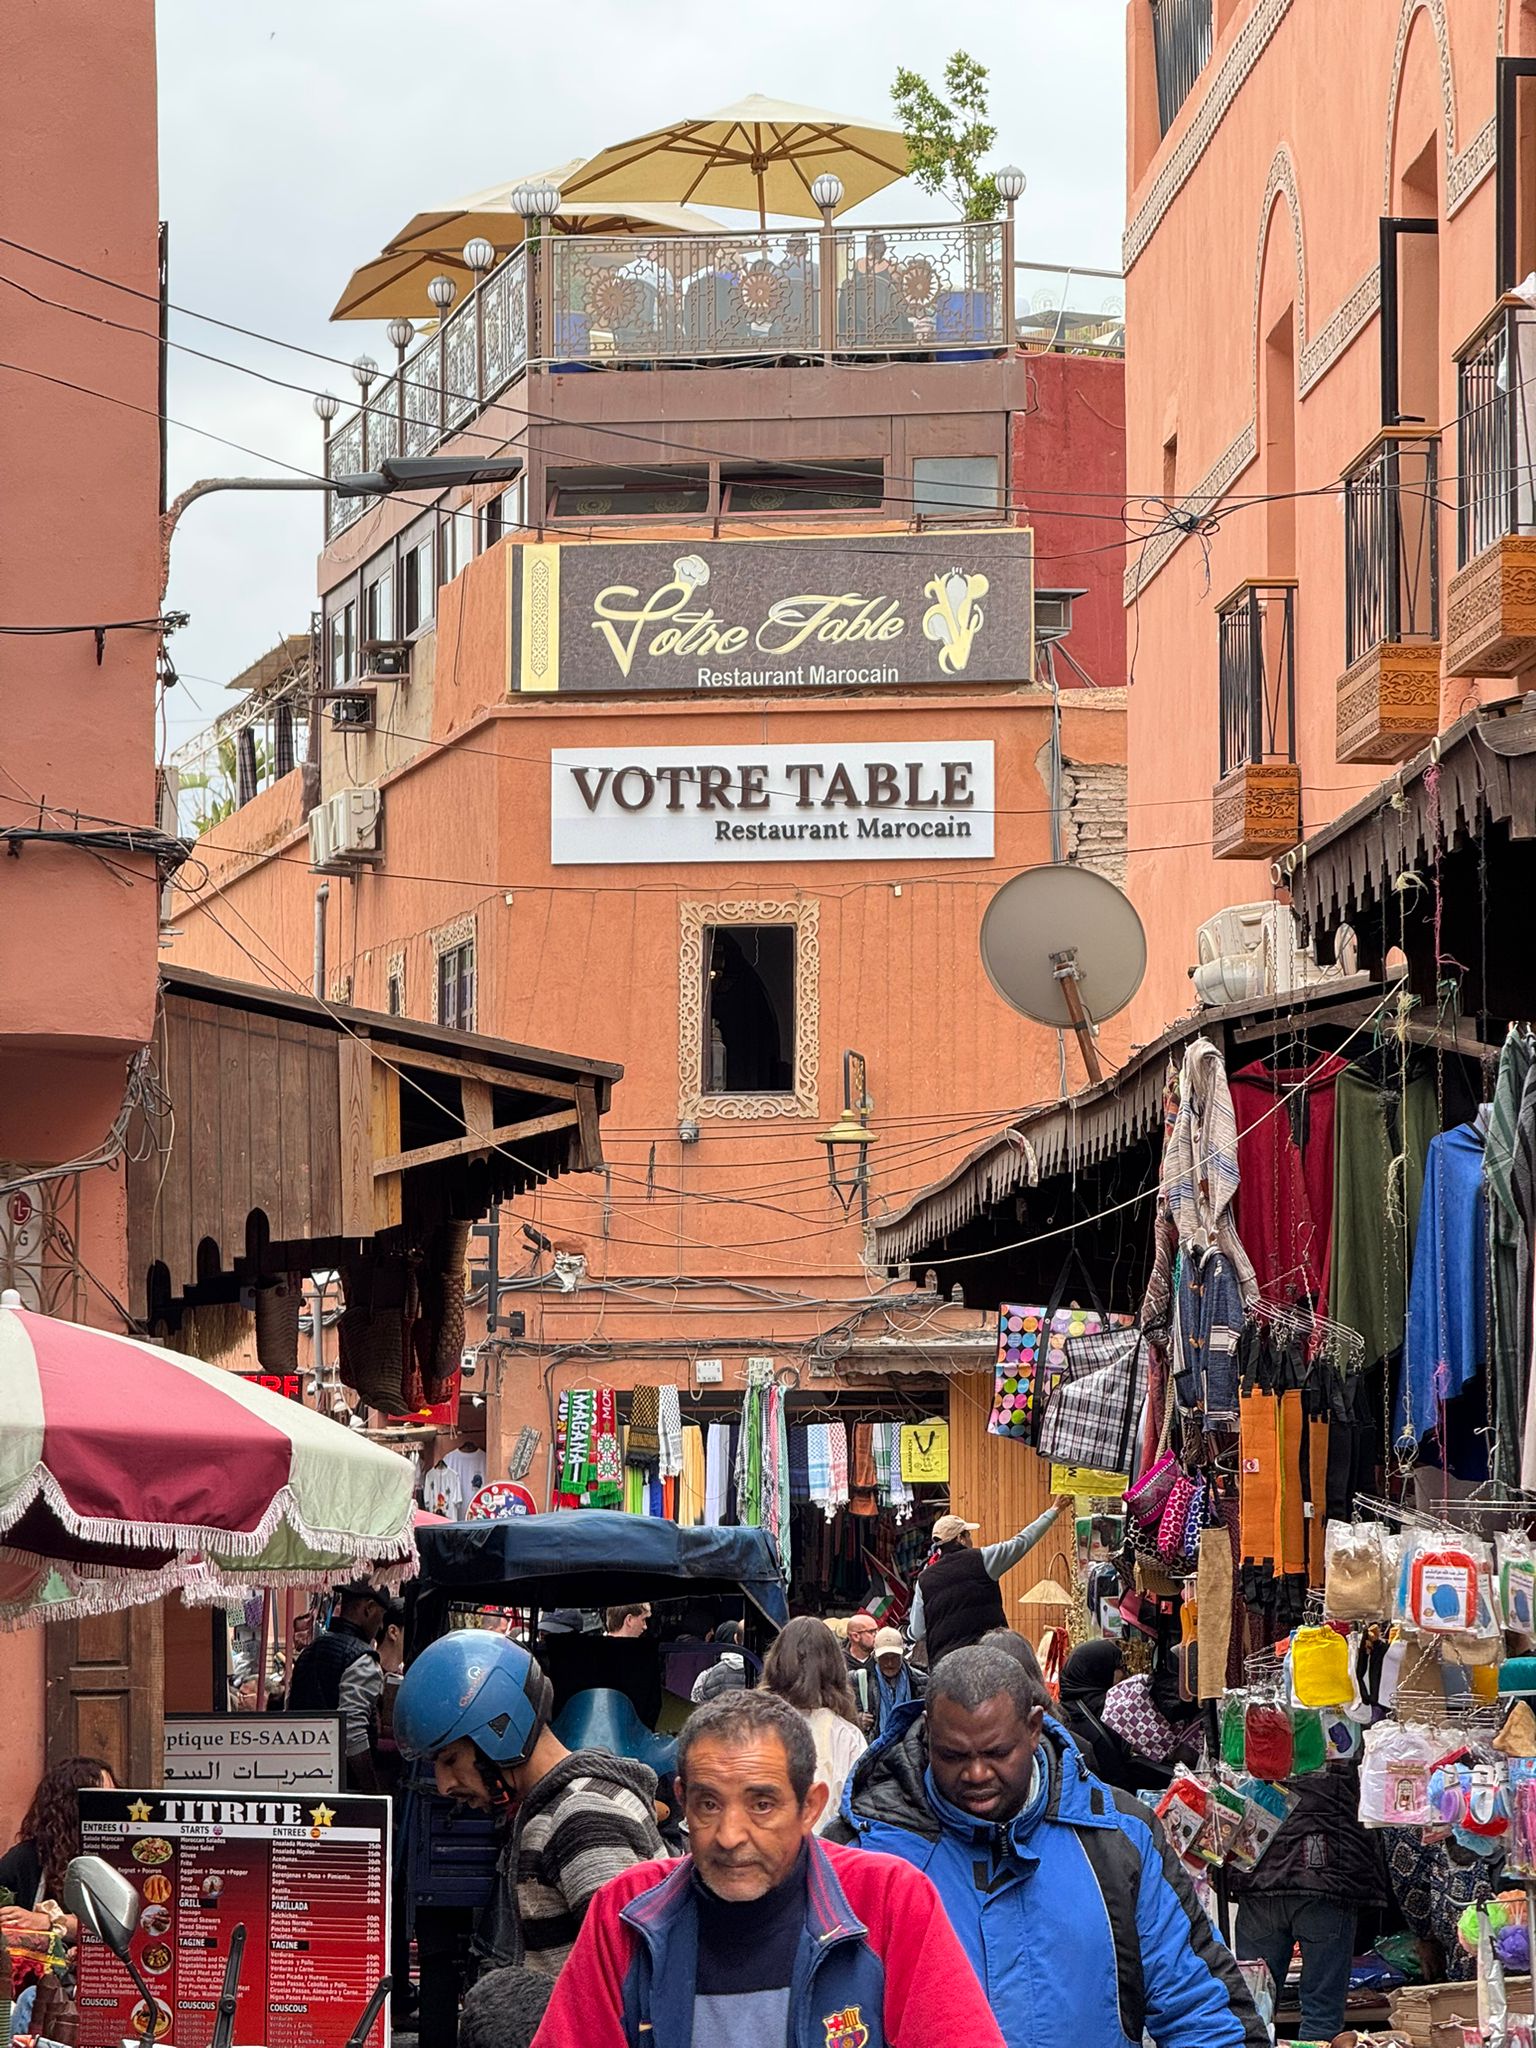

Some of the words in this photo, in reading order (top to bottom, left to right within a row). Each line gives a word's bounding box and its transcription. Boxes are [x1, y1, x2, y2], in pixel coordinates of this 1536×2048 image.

[592, 582, 748, 677] Votre
[756, 593, 905, 655] Table
[698, 668, 804, 686] Restaurant
[809, 665, 898, 684] Marocain
[570, 765, 770, 811] VOTRE
[786, 761, 974, 808] TABLE
[714, 819, 848, 841] Restaurant
[857, 816, 971, 838] Marocain
[164, 1731, 223, 1750] ptique
[230, 1730, 331, 1745] ES-SAADA
[233, 1760, 333, 1785] بصريات
[160, 1801, 302, 1824] TITRITE
[83, 1824, 117, 1832] ENTREES
[180, 1825, 209, 1834] STARTS
[272, 1828, 306, 1837] ENTREES
[179, 1898, 201, 1908] GRILL
[271, 1901, 309, 1911] PARILLADA
[82, 1935, 102, 1943] TAGI
[179, 1938, 205, 1947] TAGINE
[271, 1941, 299, 1950] TAGINE
[80, 1998, 118, 2007] COUSCOUS
[178, 2000, 216, 2010] COUSCOUS
[269, 2003, 308, 2013] COUSCOUS
